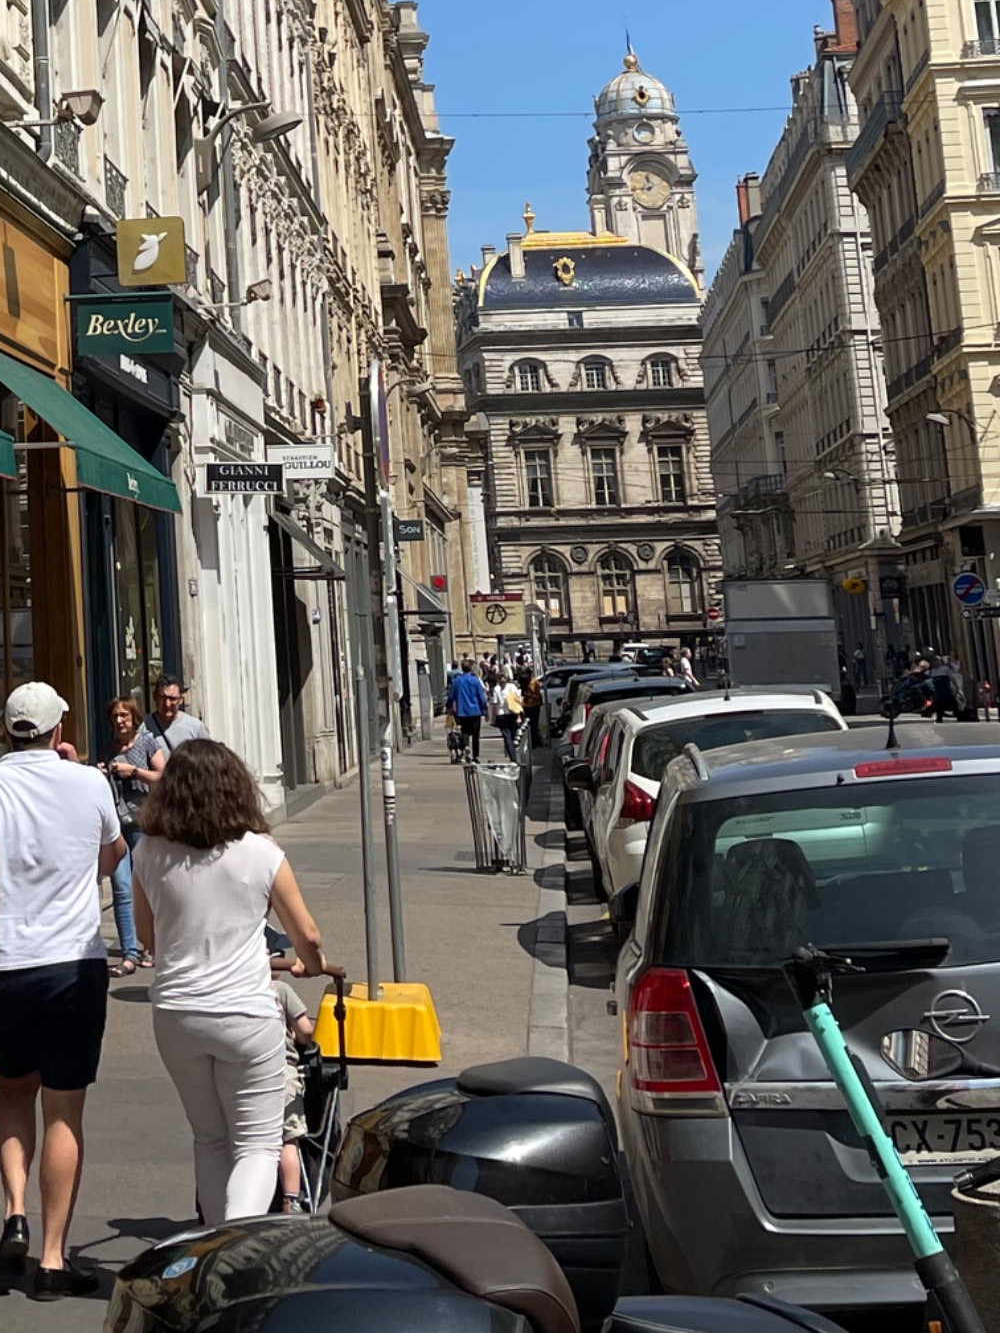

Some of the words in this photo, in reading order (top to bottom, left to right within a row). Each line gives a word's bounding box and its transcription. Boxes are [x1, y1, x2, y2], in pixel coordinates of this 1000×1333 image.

[86, 312, 160, 342] Bexley
[219, 465, 269, 476] GIANNI
[284, 460, 332, 470] GUILLOU
[211, 480, 278, 492] FERRUCCI
